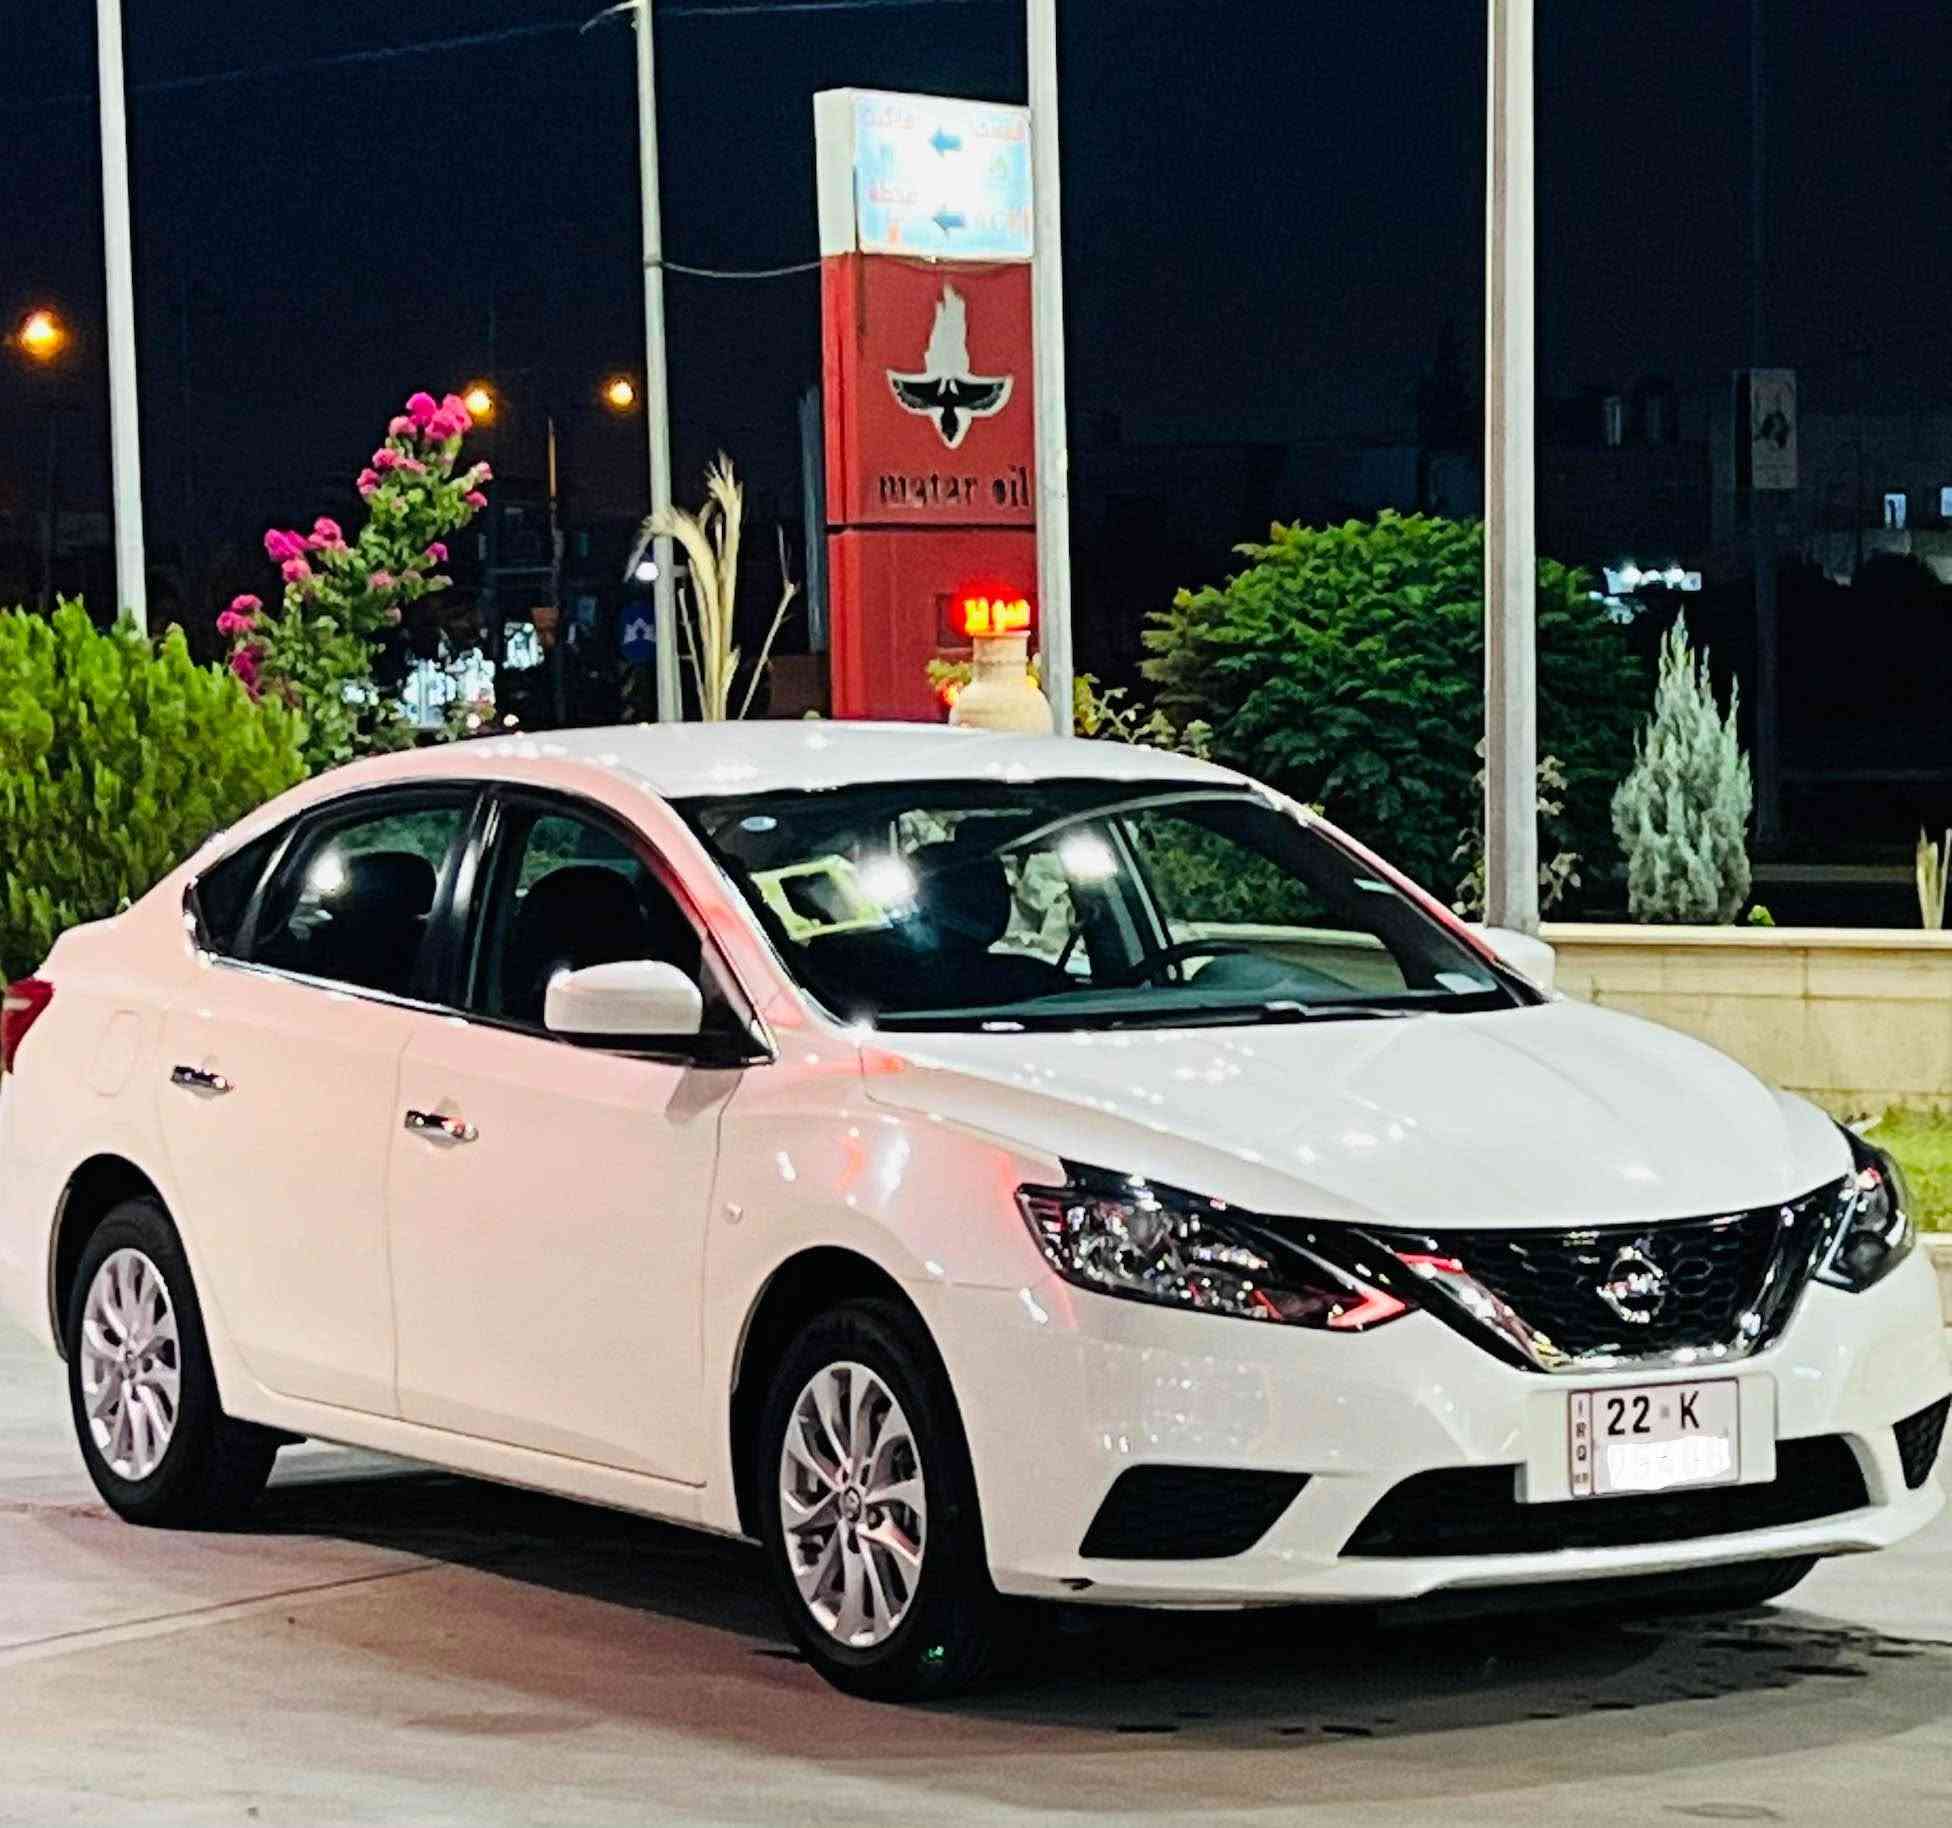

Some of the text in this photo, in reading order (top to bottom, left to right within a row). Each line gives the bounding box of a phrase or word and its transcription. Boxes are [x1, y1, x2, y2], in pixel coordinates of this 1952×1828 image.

[991, 464, 1030, 507] oil
[1607, 1391, 1701, 1436] 22 K
